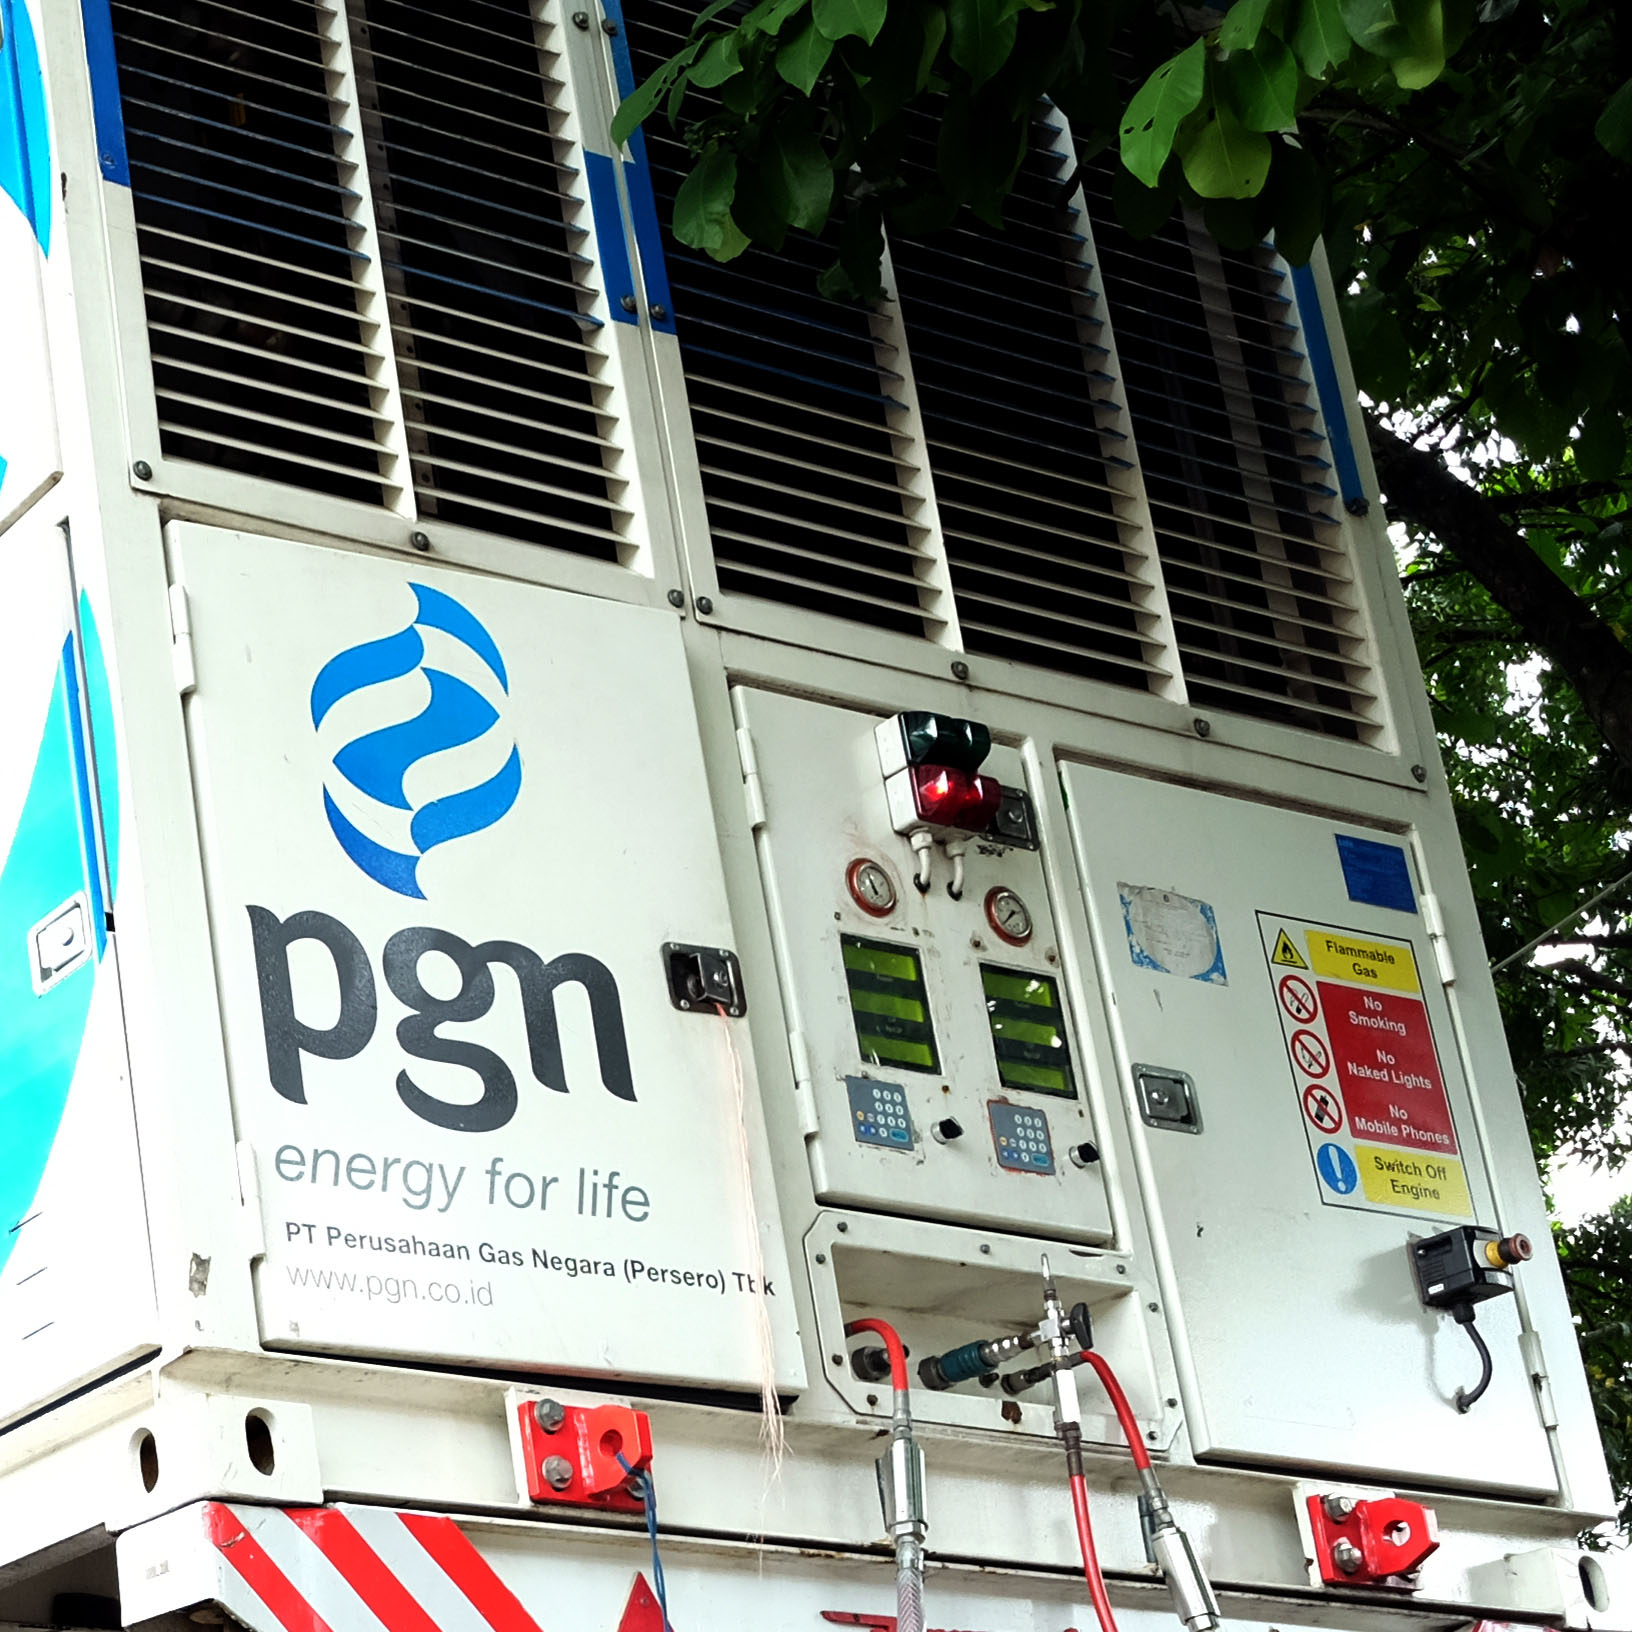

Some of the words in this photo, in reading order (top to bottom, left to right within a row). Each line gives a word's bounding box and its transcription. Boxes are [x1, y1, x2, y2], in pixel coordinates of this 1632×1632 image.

[1325, 939, 1396, 966] Flammable
[1352, 962, 1379, 980] Gas
[1363, 996, 1383, 1012] No
[244, 903, 639, 1134] pgn
[1348, 1011, 1407, 1037] Smoking
[1376, 1049, 1396, 1065] No
[1347, 1061, 1389, 1082] Naked
[1392, 1070, 1433, 1091] Lights
[1388, 1104, 1409, 1121] No
[1355, 1116, 1399, 1137] Mobile
[1401, 1124, 1451, 1146] Phones
[1373, 1156, 1422, 1179] Switch
[1425, 1164, 1448, 1182] Off
[274, 1141, 467, 1214] energy
[484, 1157, 560, 1212] for
[577, 1167, 652, 1224] life
[1391, 1179, 1441, 1201] Engine
[284, 1220, 320, 1247] PT
[326, 1224, 472, 1264] Perusahaan
[478, 1240, 526, 1268] Gas
[532, 1247, 617, 1279] Negara
[621, 1256, 728, 1295] (Persero)
[287, 1263, 495, 1309] www.pgn.co.id
